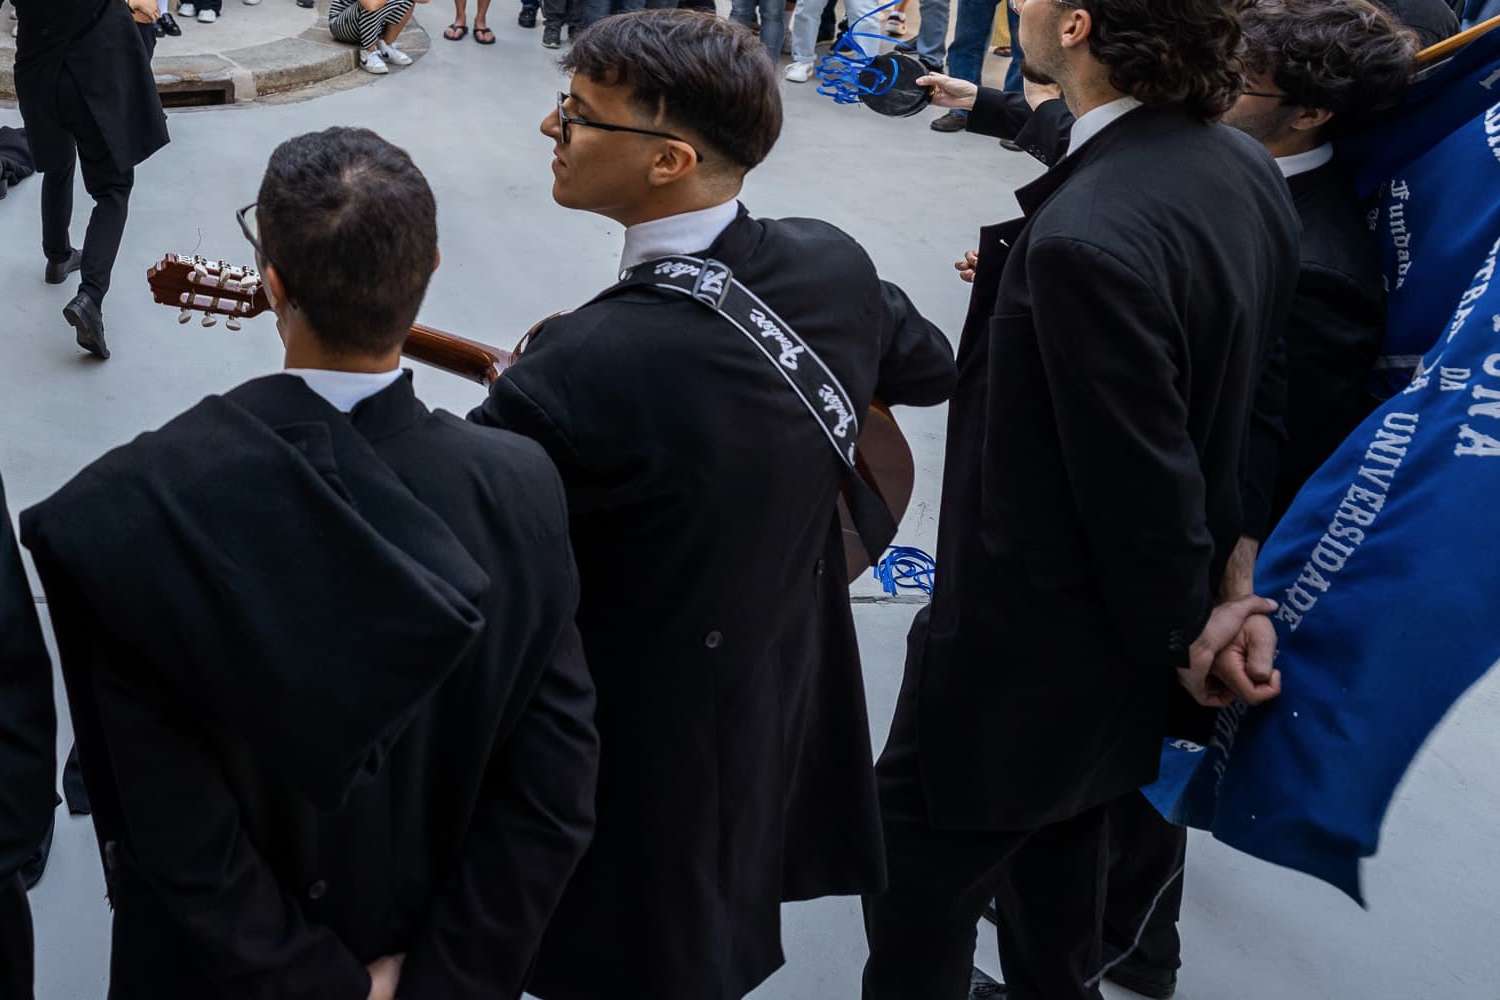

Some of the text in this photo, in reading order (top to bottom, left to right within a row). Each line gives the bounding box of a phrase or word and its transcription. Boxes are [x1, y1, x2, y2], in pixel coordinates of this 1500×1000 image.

[749, 308, 807, 372] Fender
[1440, 365, 1472, 392] DA
[818, 383, 854, 439] Fender
[1274, 411, 1420, 633] UNIVERSIDADE
